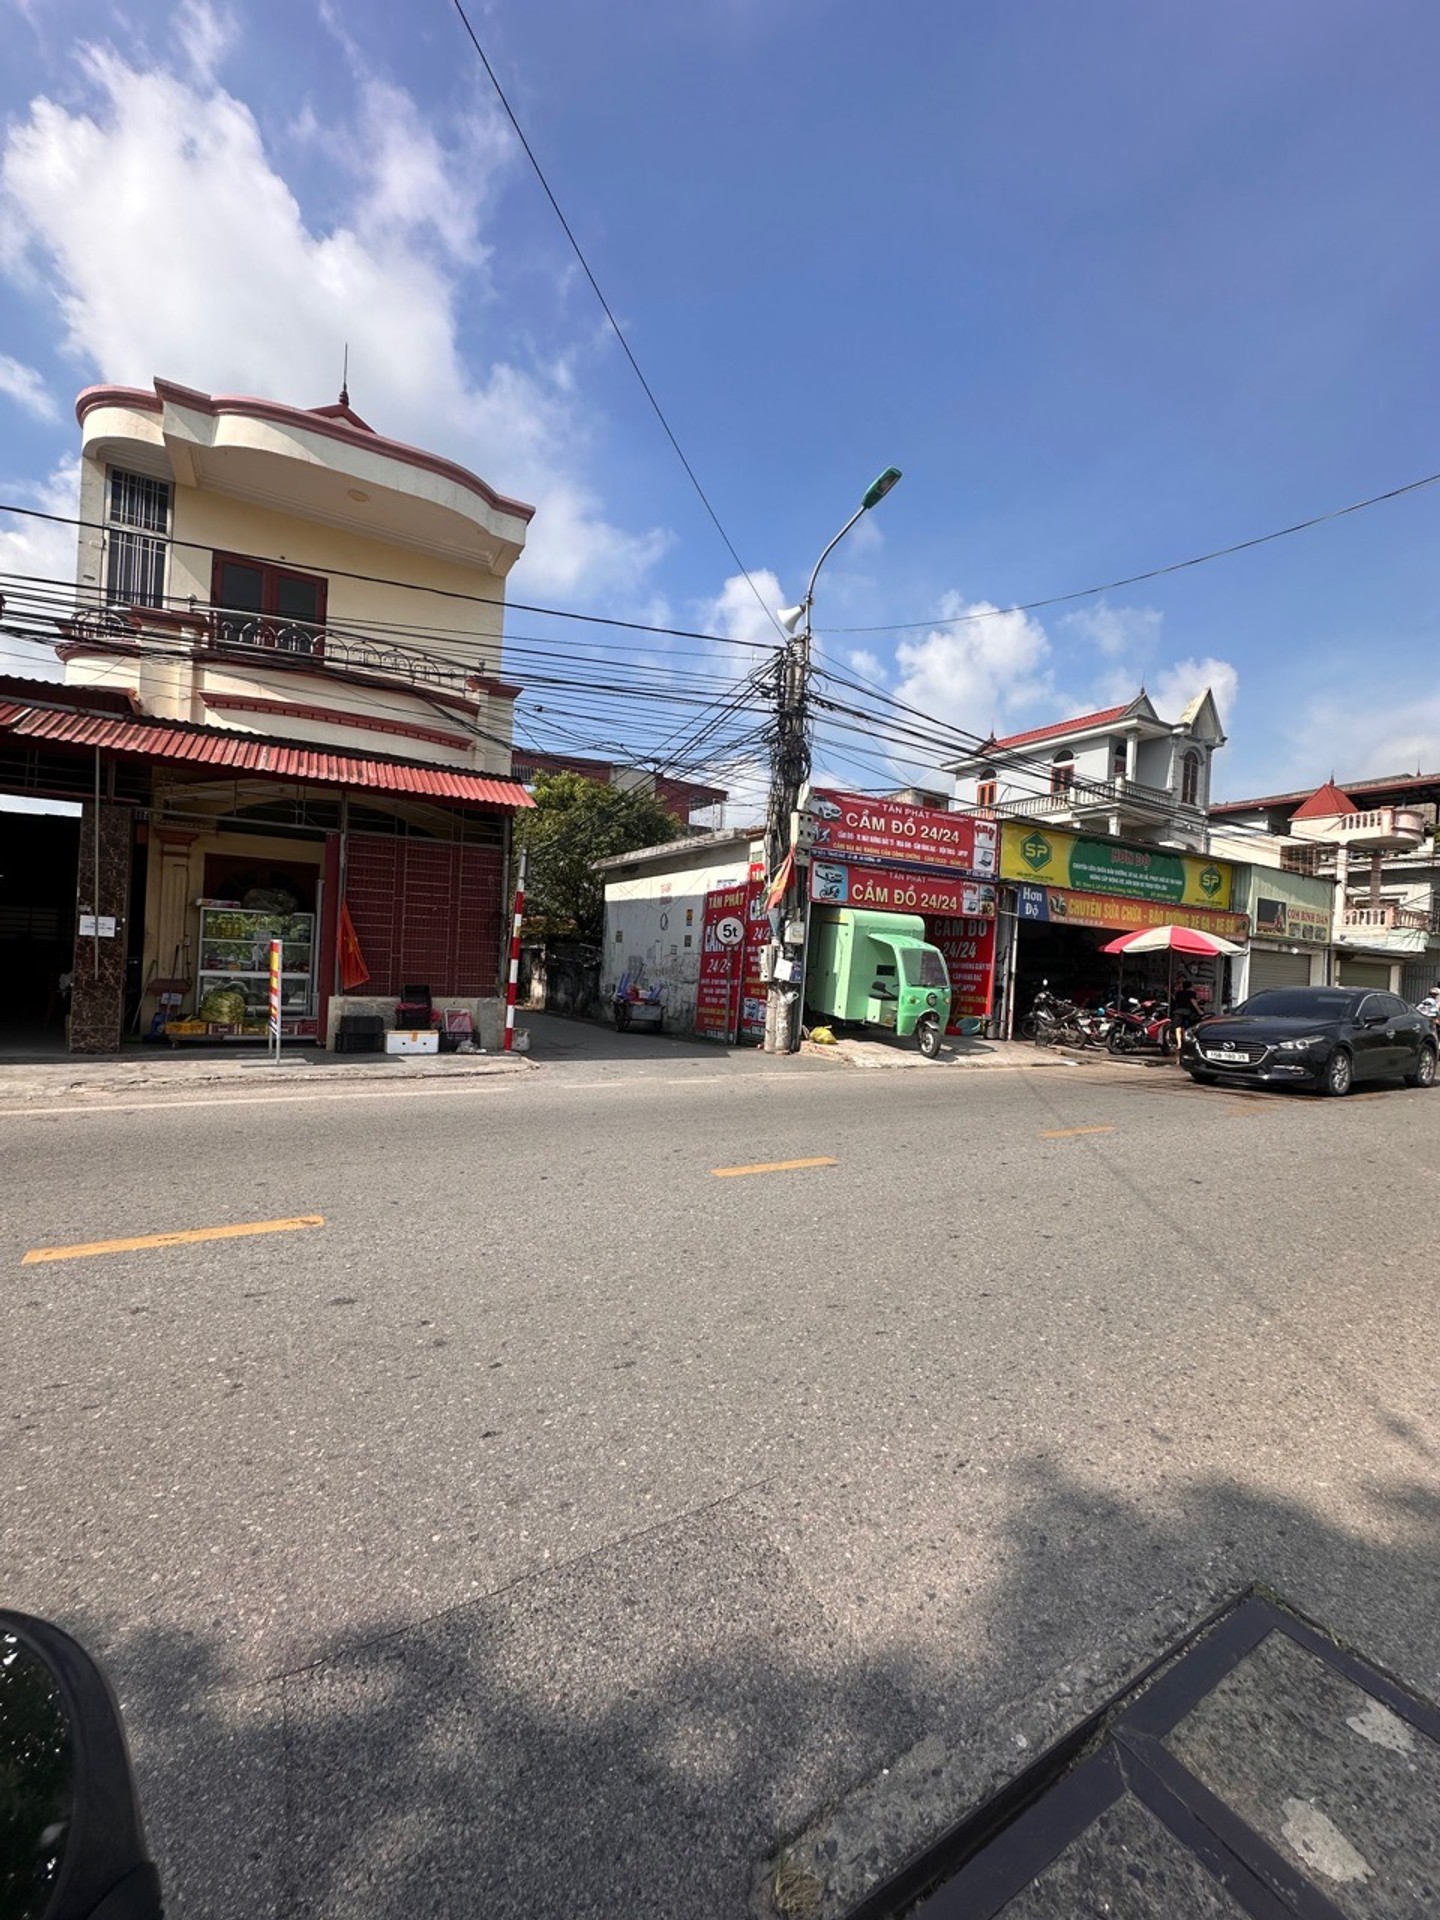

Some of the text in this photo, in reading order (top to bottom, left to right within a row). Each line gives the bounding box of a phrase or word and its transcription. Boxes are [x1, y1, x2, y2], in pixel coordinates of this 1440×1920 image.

[882, 803, 930, 819] TÂN PHÁT
[846, 809, 885, 832] CẦM
[891, 817, 916, 836] ĐỒ
[920, 825, 960, 843] 24/24
[1025, 843, 1048, 858] SP
[889, 871, 927, 884] TÂN PHÁT
[1202, 874, 1219, 888] SP
[709, 889, 745, 909] TÂN PHÁT
[852, 879, 957, 910] CẦM ĐỒ 24/24
[1023, 887, 1043, 902] Hơn
[1025, 902, 1039, 919] Độ
[1068, 898, 1102, 918] CHUYÊN
[1103, 898, 1120, 920] SỬA
[1121, 904, 1142, 922] CHỮA
[1190, 914, 1200, 928] XE
[723, 923, 738, 939] 5t
[943, 941, 977, 958] 24/24
